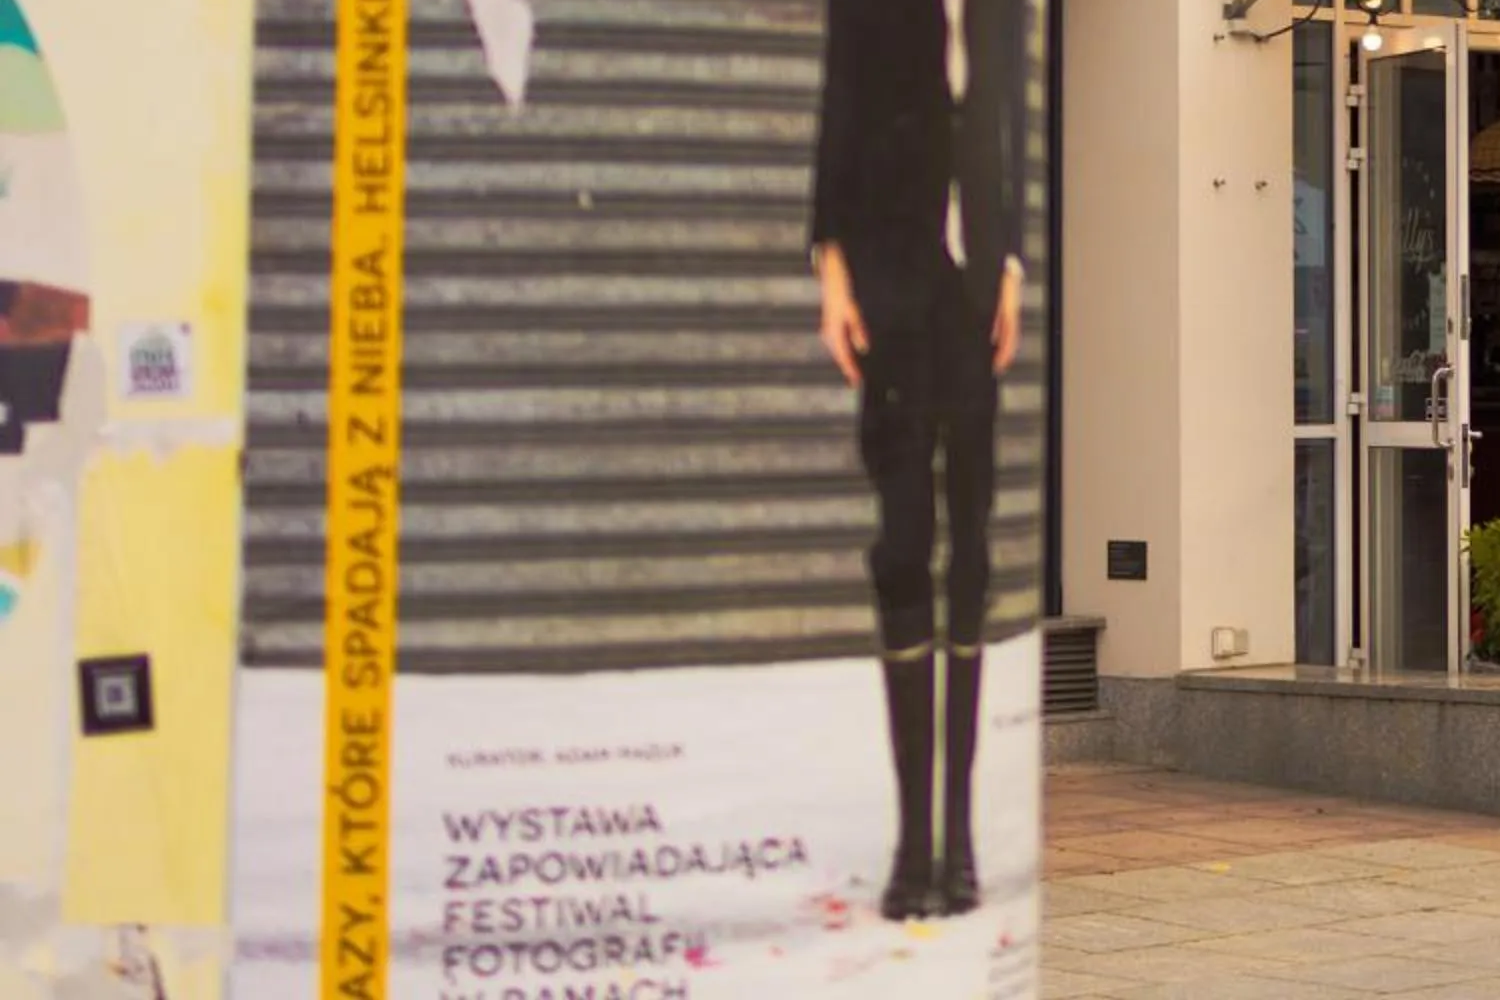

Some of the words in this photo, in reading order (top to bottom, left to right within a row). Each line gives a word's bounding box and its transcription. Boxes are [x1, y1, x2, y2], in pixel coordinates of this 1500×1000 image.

[348, 416, 385, 446] Z
[343, 461, 392, 690] SPADAJĄ
[331, 709, 379, 876] KTÓRE
[442, 804, 664, 843] WYSTAWA
[444, 836, 809, 890] ZAPOWIADAJĄCA
[443, 895, 661, 934] FESTIWAL
